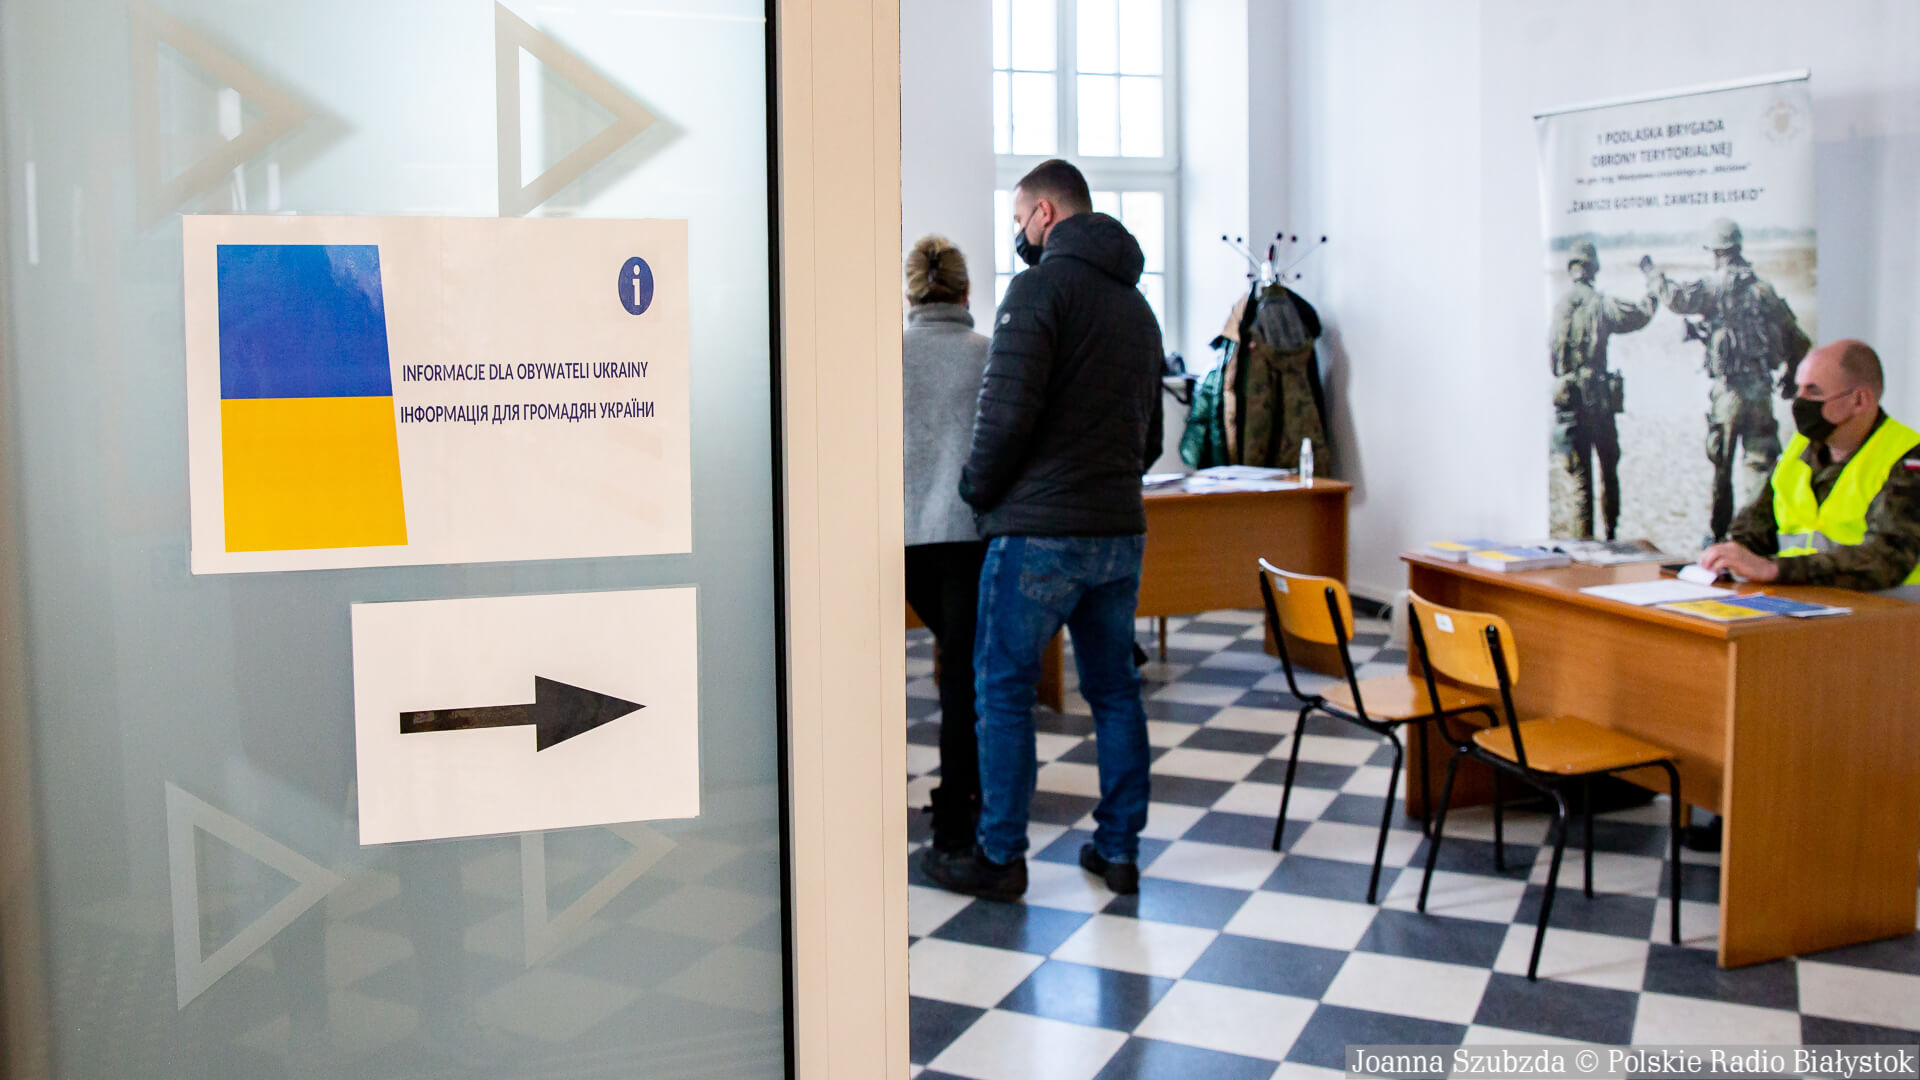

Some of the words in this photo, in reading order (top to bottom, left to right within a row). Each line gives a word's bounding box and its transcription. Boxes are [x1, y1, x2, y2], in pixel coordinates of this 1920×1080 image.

[1605, 127, 1664, 144] PODLASKA
[1667, 119, 1724, 138] BRYGADA
[1591, 151, 1637, 168] OBRONY
[1640, 141, 1733, 162] TERYTORIALNEJ
[1664, 192, 1709, 207] ZAWSZE
[402, 363, 486, 382] INFORMACJE
[489, 363, 514, 380] DLA
[517, 362, 589, 380] OBYWATELI
[593, 361, 648, 378] UKRAINY
[400, 405, 488, 425] ІНФОРМАЦІЯ
[492, 404, 520, 425] ДЛЯ
[523, 402, 597, 423] ГРОМАДЯН
[599, 397, 654, 419] УКРАЇНИ
